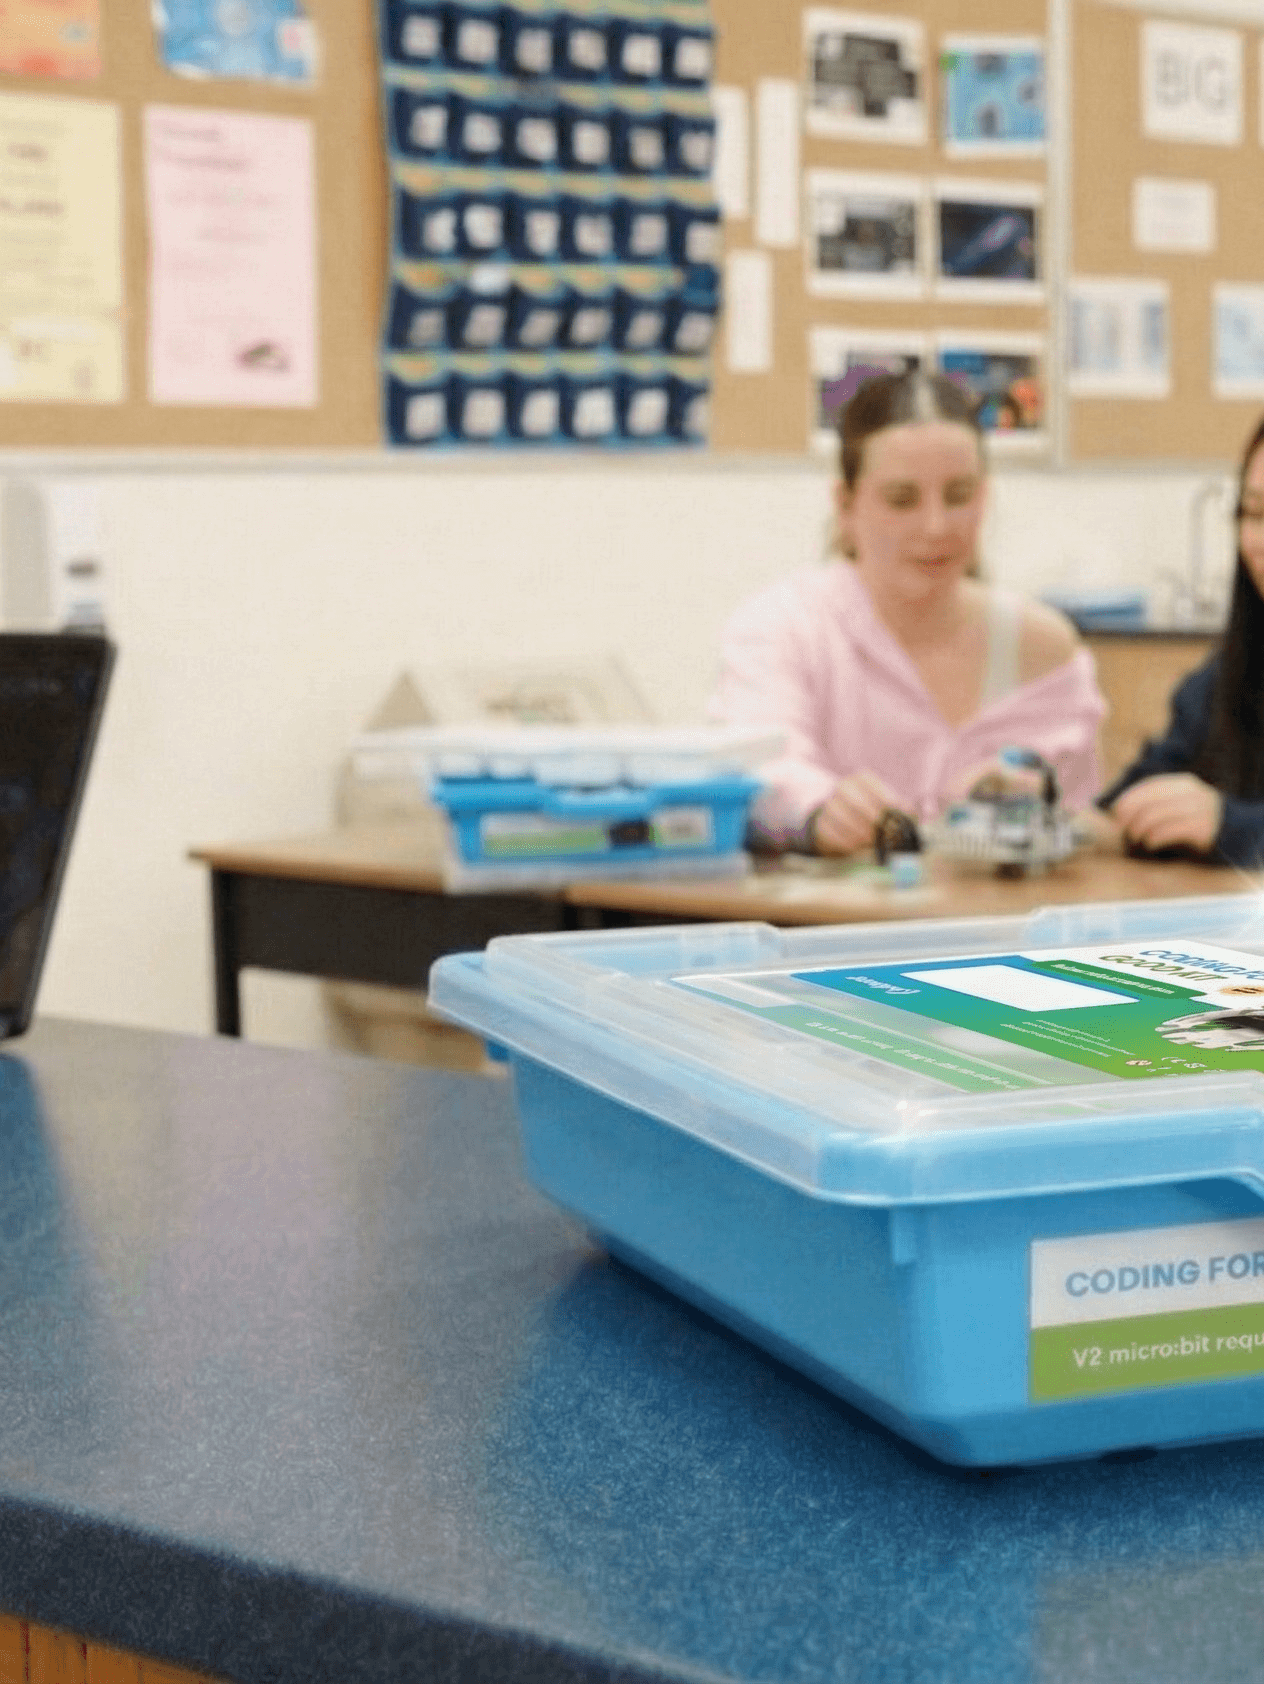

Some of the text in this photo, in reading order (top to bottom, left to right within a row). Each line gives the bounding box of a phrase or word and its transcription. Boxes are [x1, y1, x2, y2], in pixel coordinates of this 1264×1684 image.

[1154, 50, 1230, 114] BIG
[1098, 954, 1185, 973] GOOD
[1168, 970, 1230, 982] KIT
[1065, 1259, 1200, 1298] CODING
[1073, 1346, 1102, 1370] V2
[1109, 1335, 1210, 1366] micro:bit
